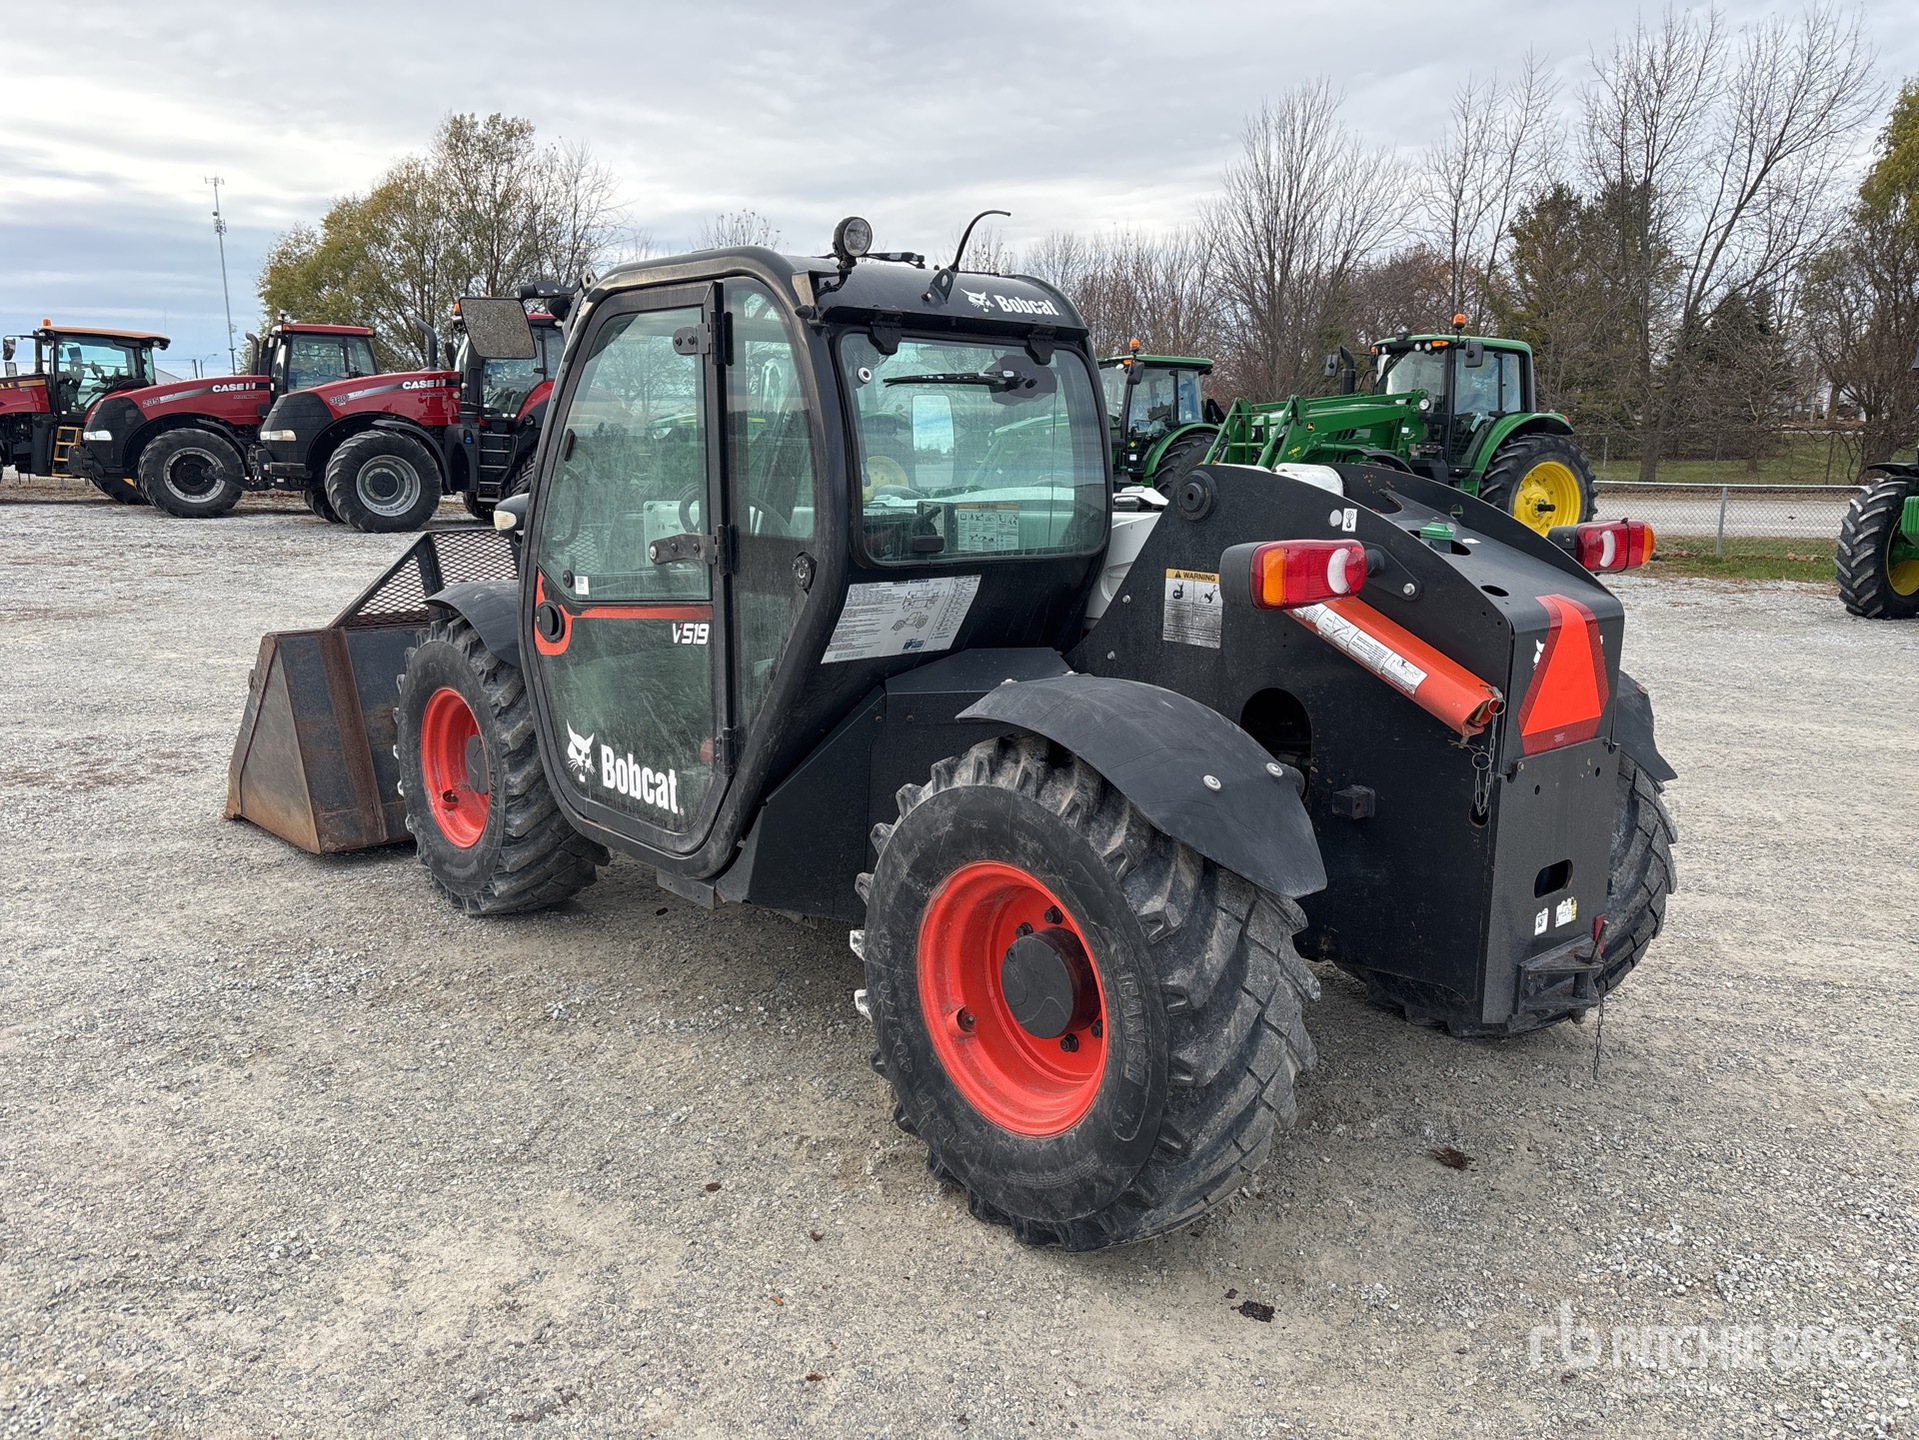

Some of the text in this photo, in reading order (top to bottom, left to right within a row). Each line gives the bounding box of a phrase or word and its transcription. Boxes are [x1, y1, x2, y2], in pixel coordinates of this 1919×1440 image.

[992, 294, 1060, 316] Bobcat
[212, 383, 244, 393] CASE
[402, 380, 435, 390] CASE
[329, 394, 349, 406] 380
[1182, 571, 1217, 582] WARNING
[672, 622, 710, 645] V519
[601, 743, 679, 815] Bobcat
[1118, 973, 1147, 1086] CAMSO
